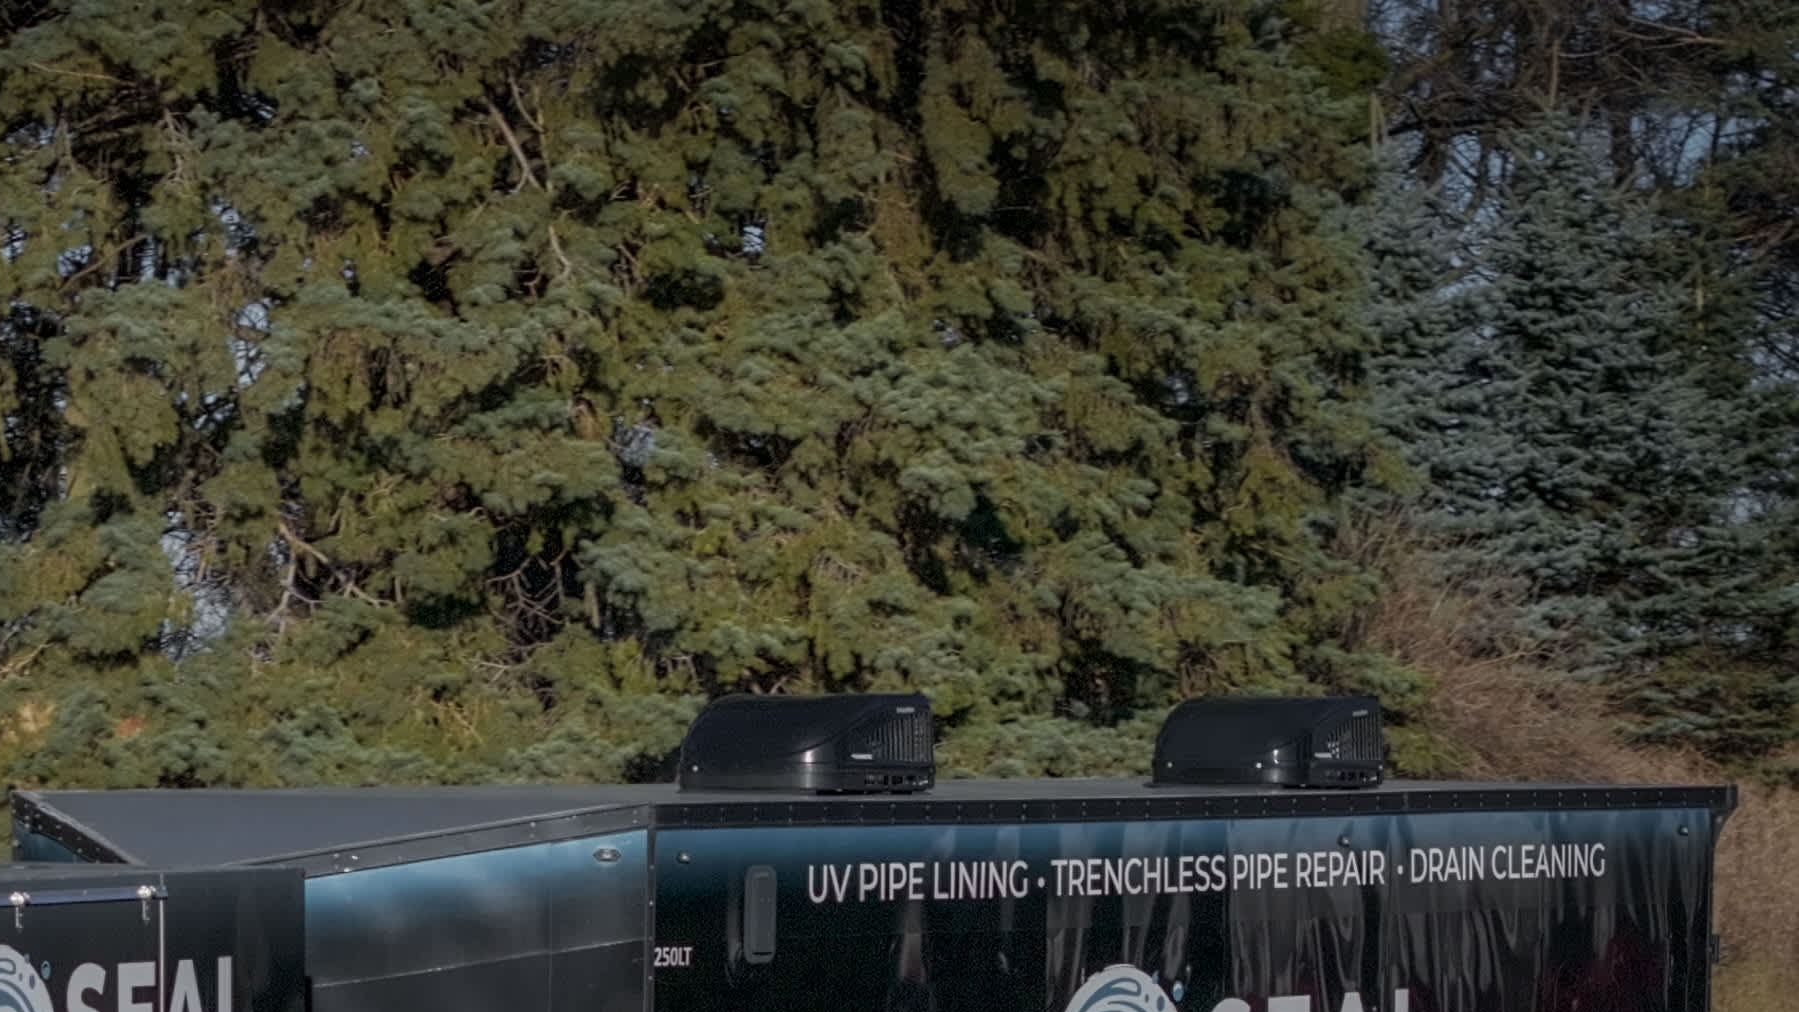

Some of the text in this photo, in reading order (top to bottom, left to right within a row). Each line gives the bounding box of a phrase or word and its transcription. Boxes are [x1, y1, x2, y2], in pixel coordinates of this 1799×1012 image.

[807, 842, 1606, 903] UV PIPE LINING TRENCHLESS PIPE REPAIR DRAIN CLEANING
[653, 946, 693, 967] 250LT
